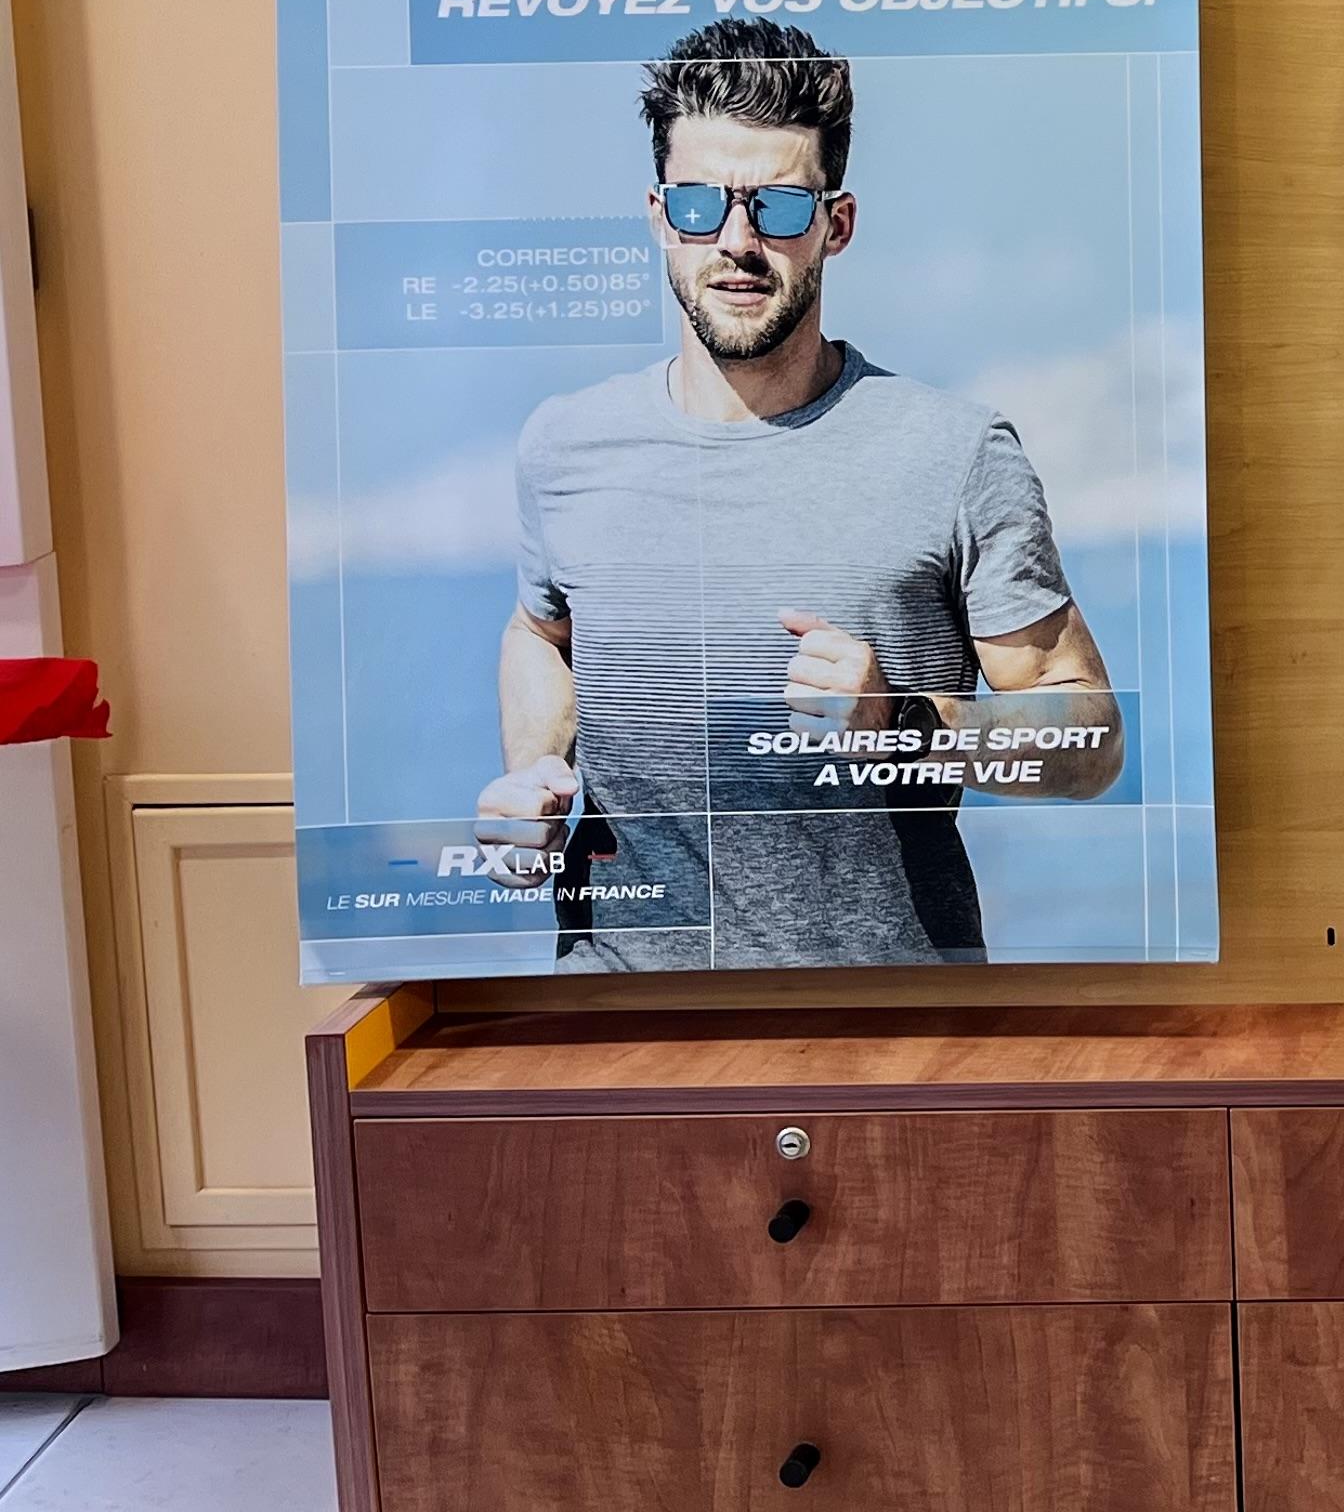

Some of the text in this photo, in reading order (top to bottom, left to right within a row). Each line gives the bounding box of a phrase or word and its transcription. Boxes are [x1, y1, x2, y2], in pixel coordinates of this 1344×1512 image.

[477, 247, 650, 268] CORRECTION
[403, 277, 437, 295] RE
[407, 303, 438, 321] LE
[747, 726, 1109, 755] SOLAIRES DE SPORT
[813, 760, 1043, 787] A VOTRE VUE
[327, 884, 667, 911] LE SUR MESURE MADE IN FRANCE
